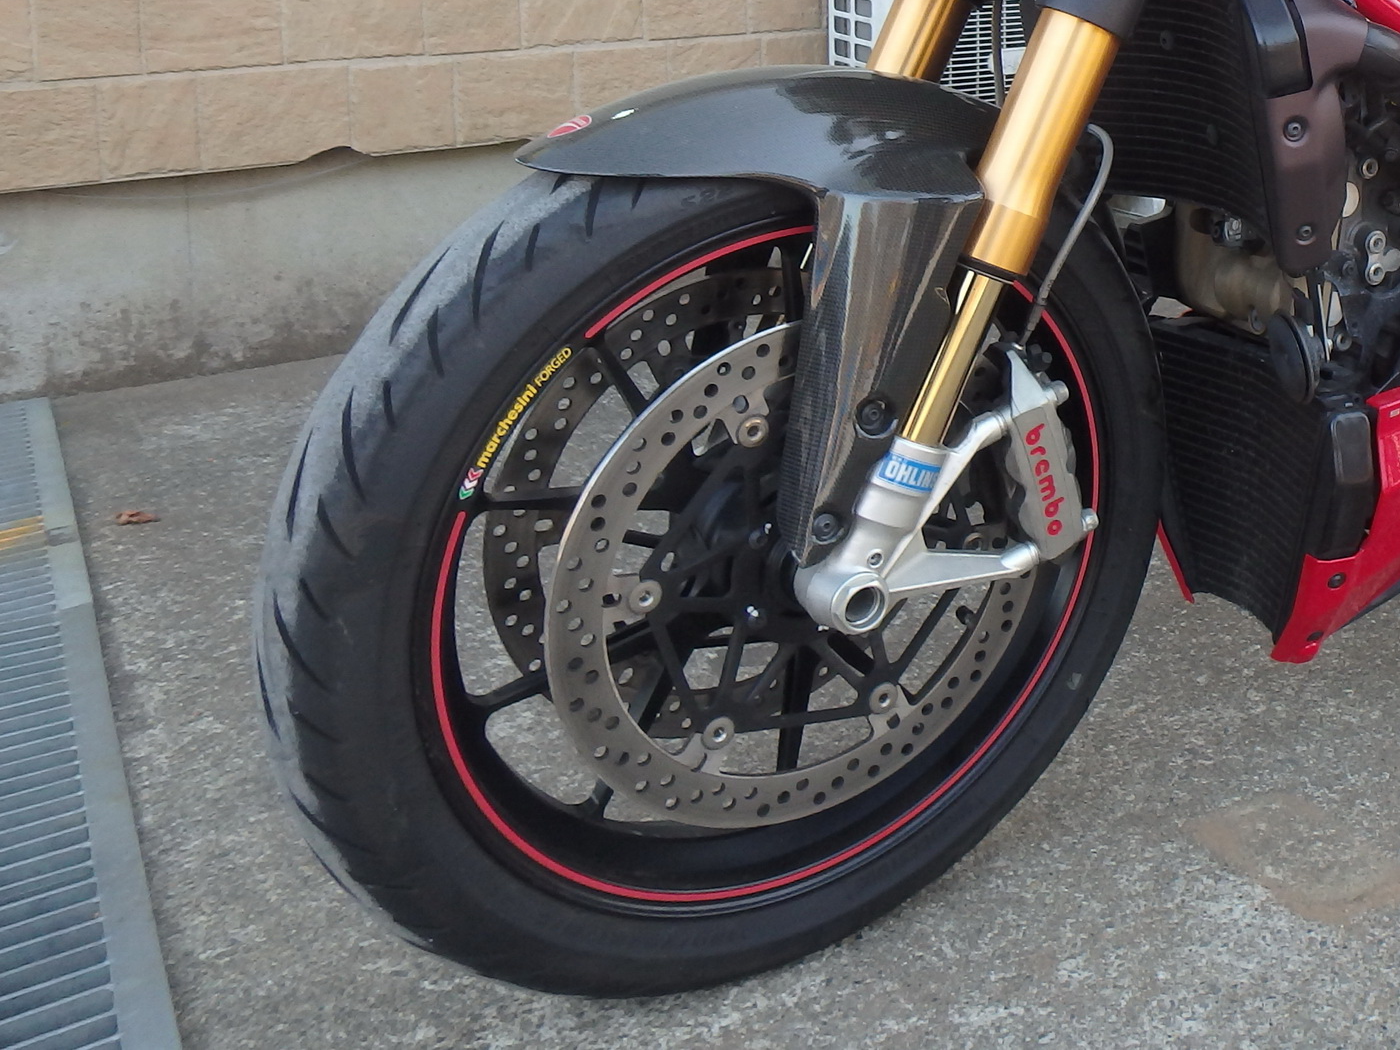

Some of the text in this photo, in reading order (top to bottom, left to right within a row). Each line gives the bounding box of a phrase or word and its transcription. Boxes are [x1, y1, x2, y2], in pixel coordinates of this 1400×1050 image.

[476, 347, 572, 469] marchesini FORGED
[1025, 423, 1065, 536] brembo
